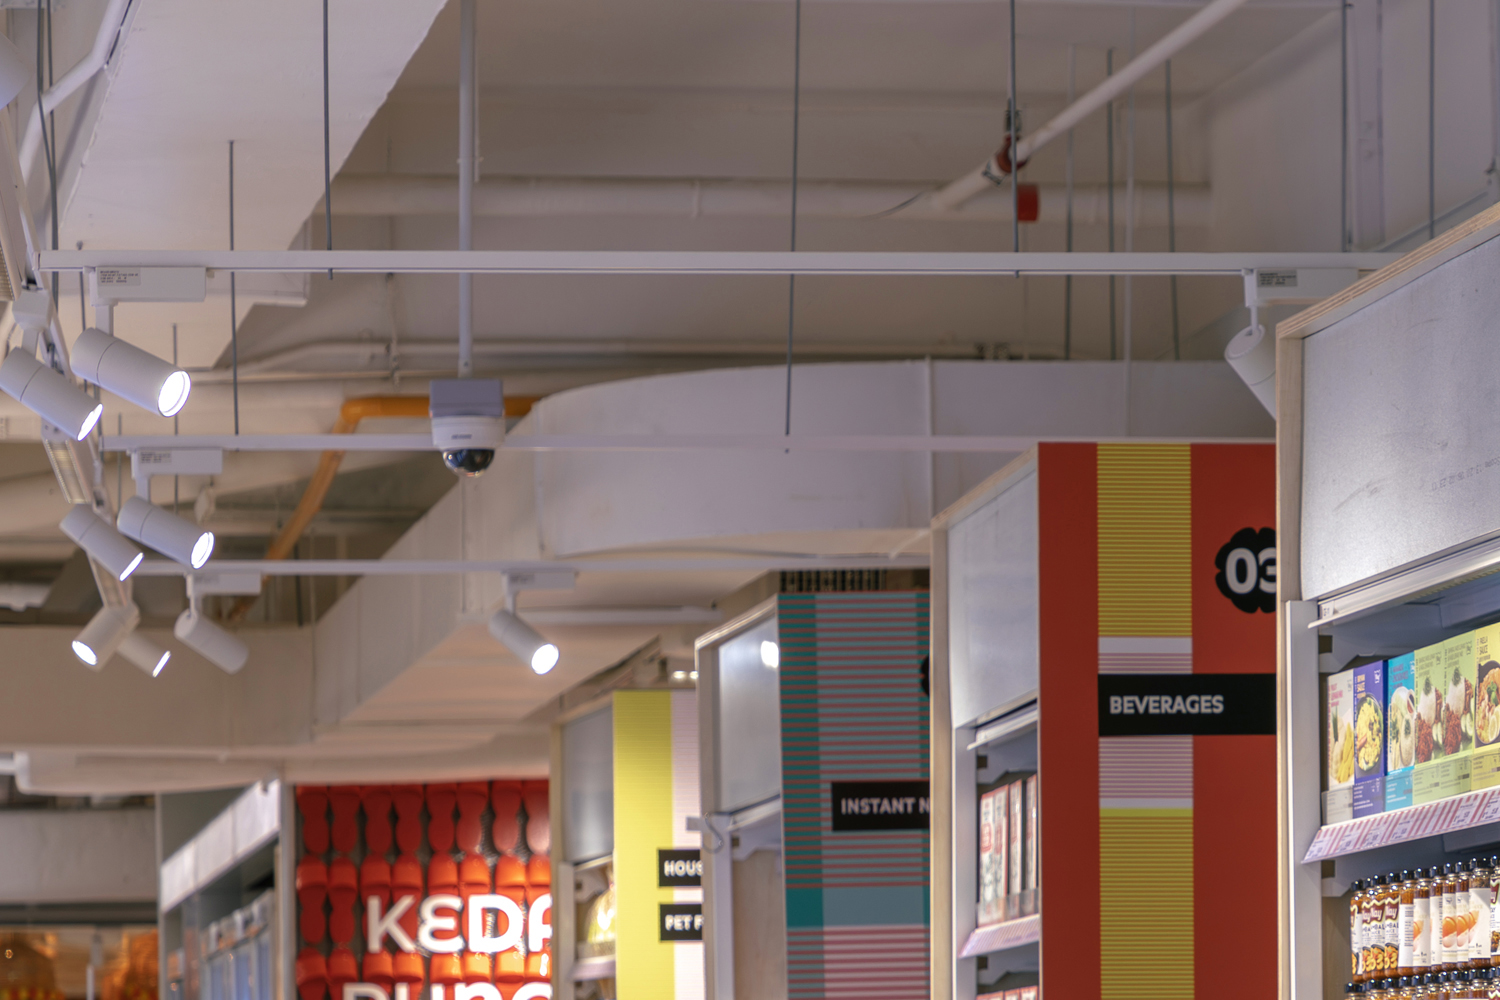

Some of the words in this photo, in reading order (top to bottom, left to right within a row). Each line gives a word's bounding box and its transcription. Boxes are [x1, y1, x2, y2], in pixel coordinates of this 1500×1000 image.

[1110, 696, 1224, 714] BEVERAGES
[841, 798, 916, 815] INSTANT
[665, 914, 692, 931] PET
